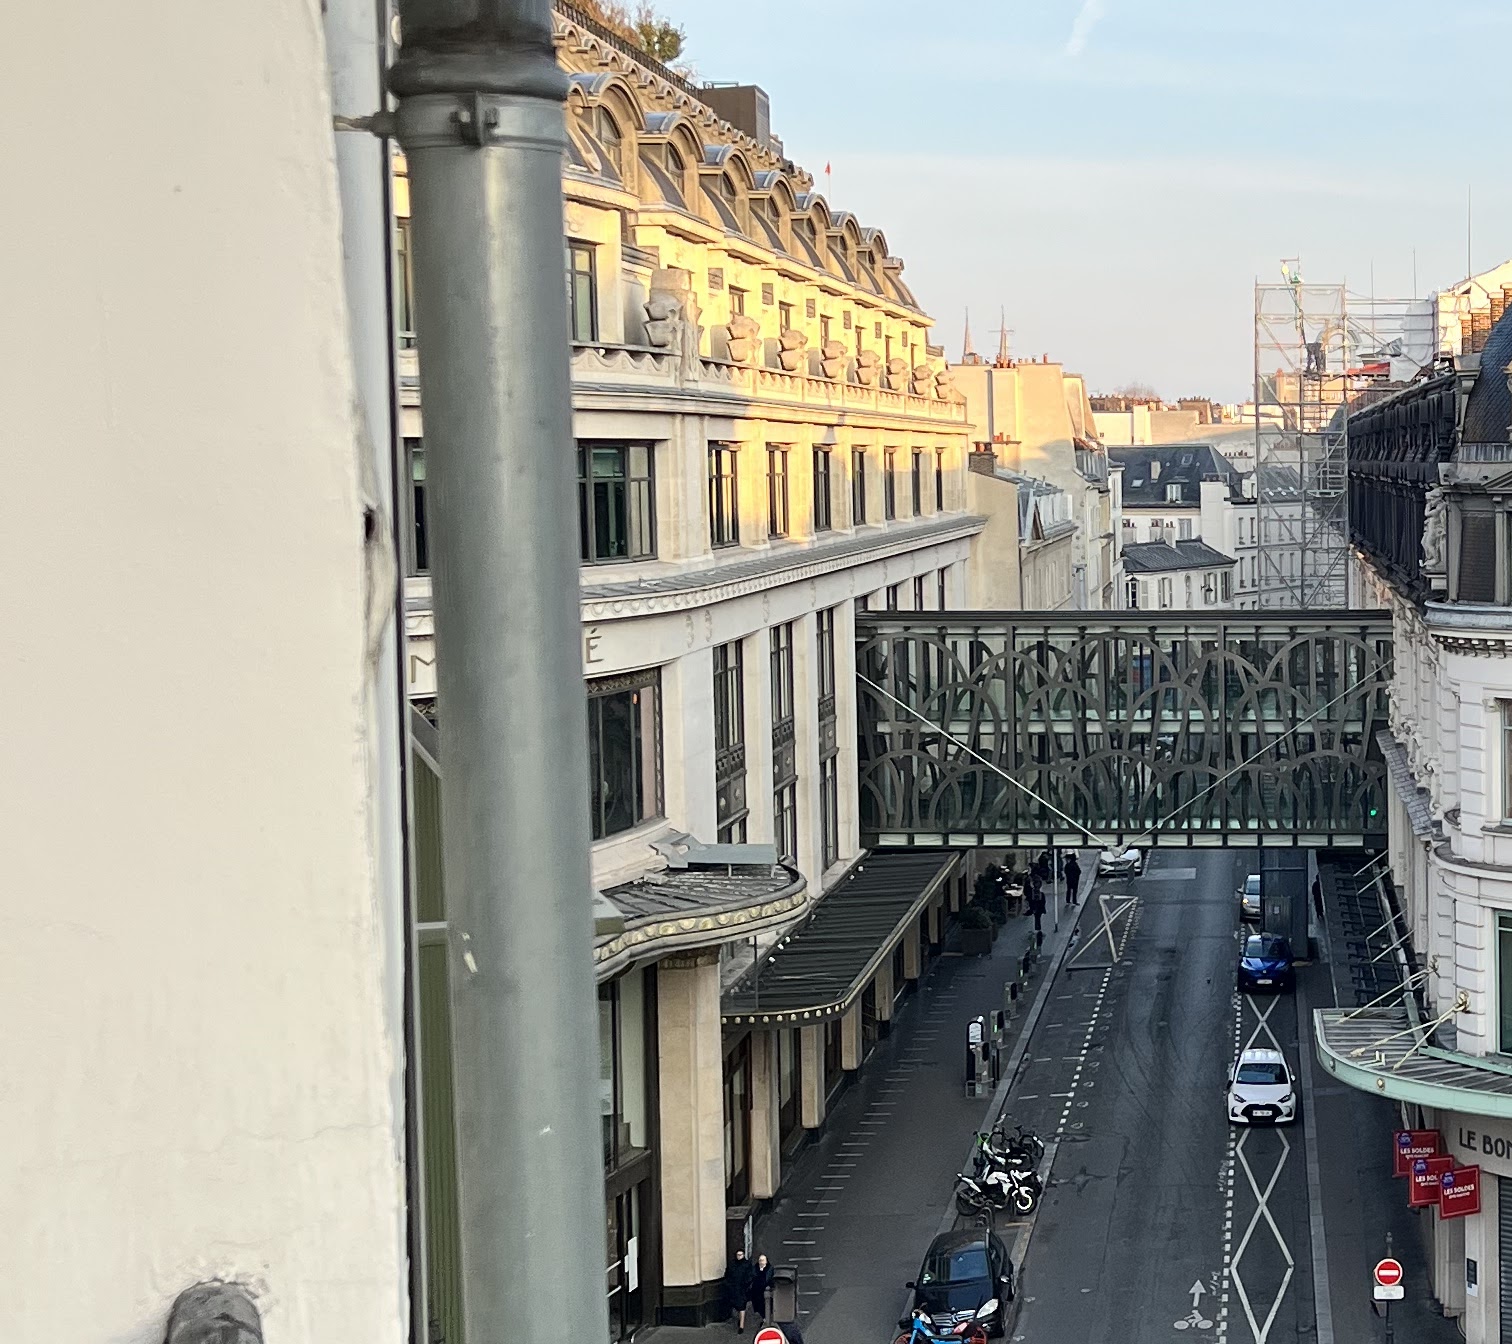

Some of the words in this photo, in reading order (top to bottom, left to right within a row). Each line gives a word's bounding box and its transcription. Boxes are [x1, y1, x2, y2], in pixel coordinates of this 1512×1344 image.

[1459, 1127, 1477, 1150] LE
[1400, 1147, 1410, 1155] LES
[1415, 1175, 1426, 1183] LES
[1443, 1188, 1453, 1196] LES
[1454, 1183, 1475, 1194] SOLDES
